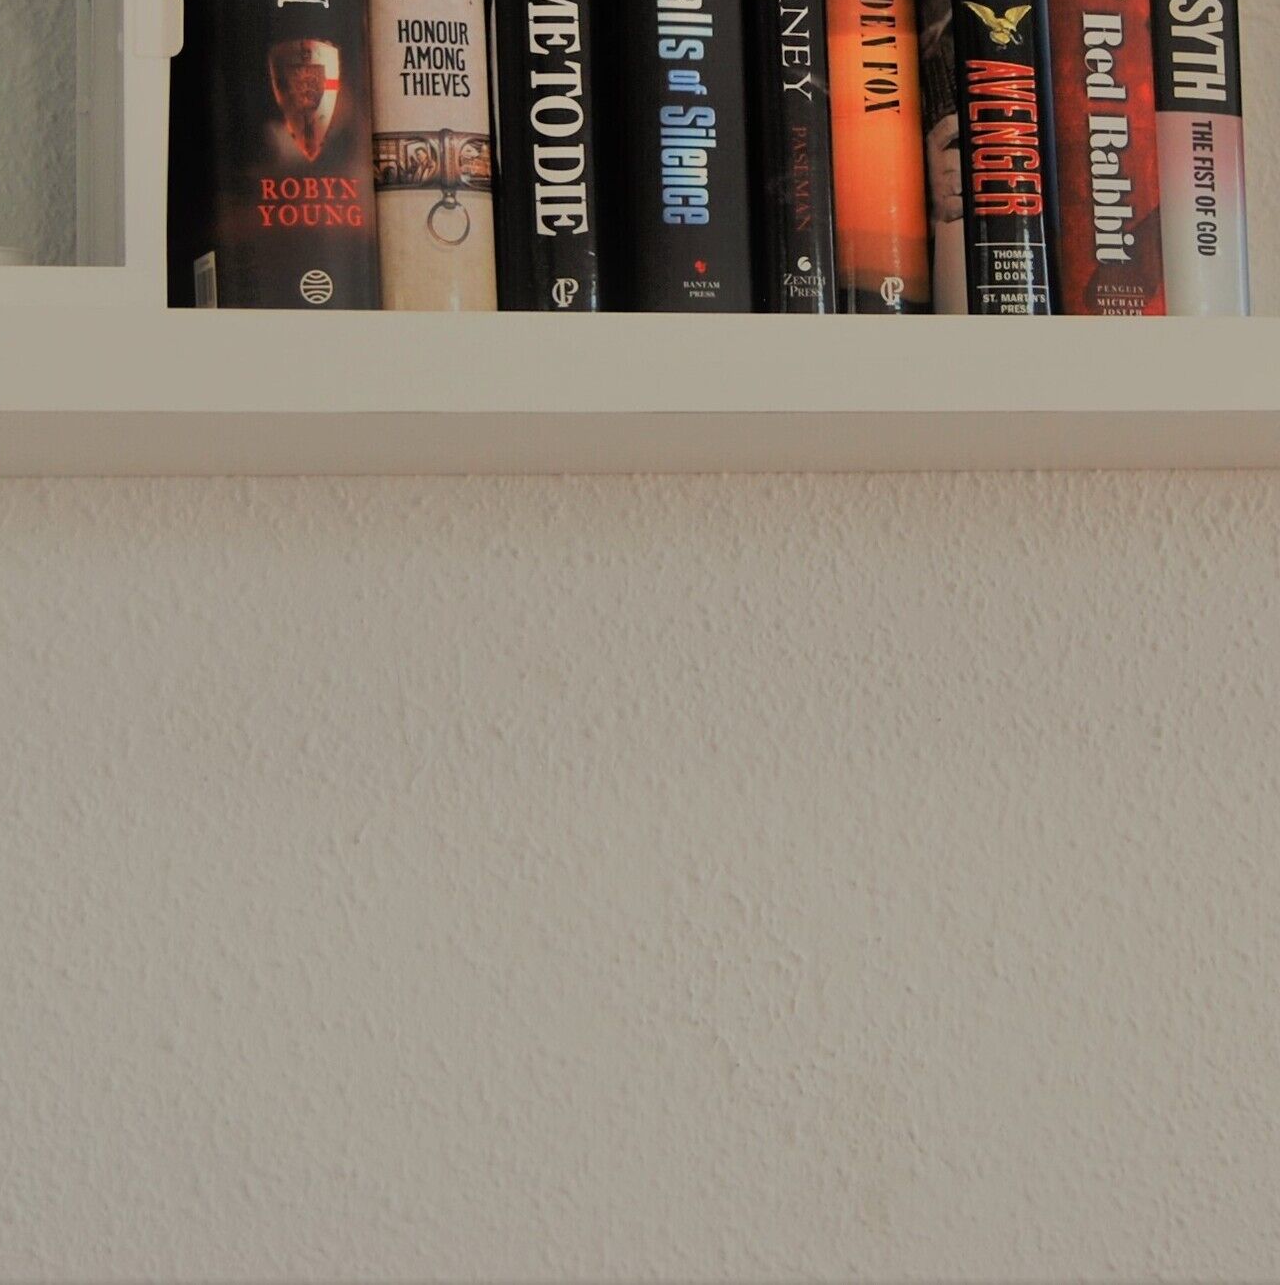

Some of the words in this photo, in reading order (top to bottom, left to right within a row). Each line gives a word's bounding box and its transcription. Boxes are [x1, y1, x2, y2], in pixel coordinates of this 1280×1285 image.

[397, 19, 470, 46] HONOUR
[403, 45, 466, 71] AMONG
[1081, 11, 1128, 102] Red
[400, 72, 471, 98] THIEVES
[668, 69, 708, 96] of
[862, 60, 900, 115] FOX
[530, 60, 584, 138] TO
[965, 59, 1044, 216] AVENGER
[1191, 120, 1214, 152] THE
[659, 105, 717, 225] Silence
[791, 125, 813, 233] PASEMAN
[1193, 155, 1216, 192] FIST
[261, 178, 360, 201] ROBYN
[533, 143, 589, 237] DIE
[1087, 112, 1136, 266] Rabbit
[258, 204, 365, 227] YOUNG
[1195, 195, 1217, 218] OF
[1196, 221, 1218, 257] GOD
[683, 280, 720, 289] BANTAM
[689, 290, 716, 298] PRESS
[1096, 284, 1144, 294] PENGUIN
[1096, 297, 1146, 308] MICHAEL
